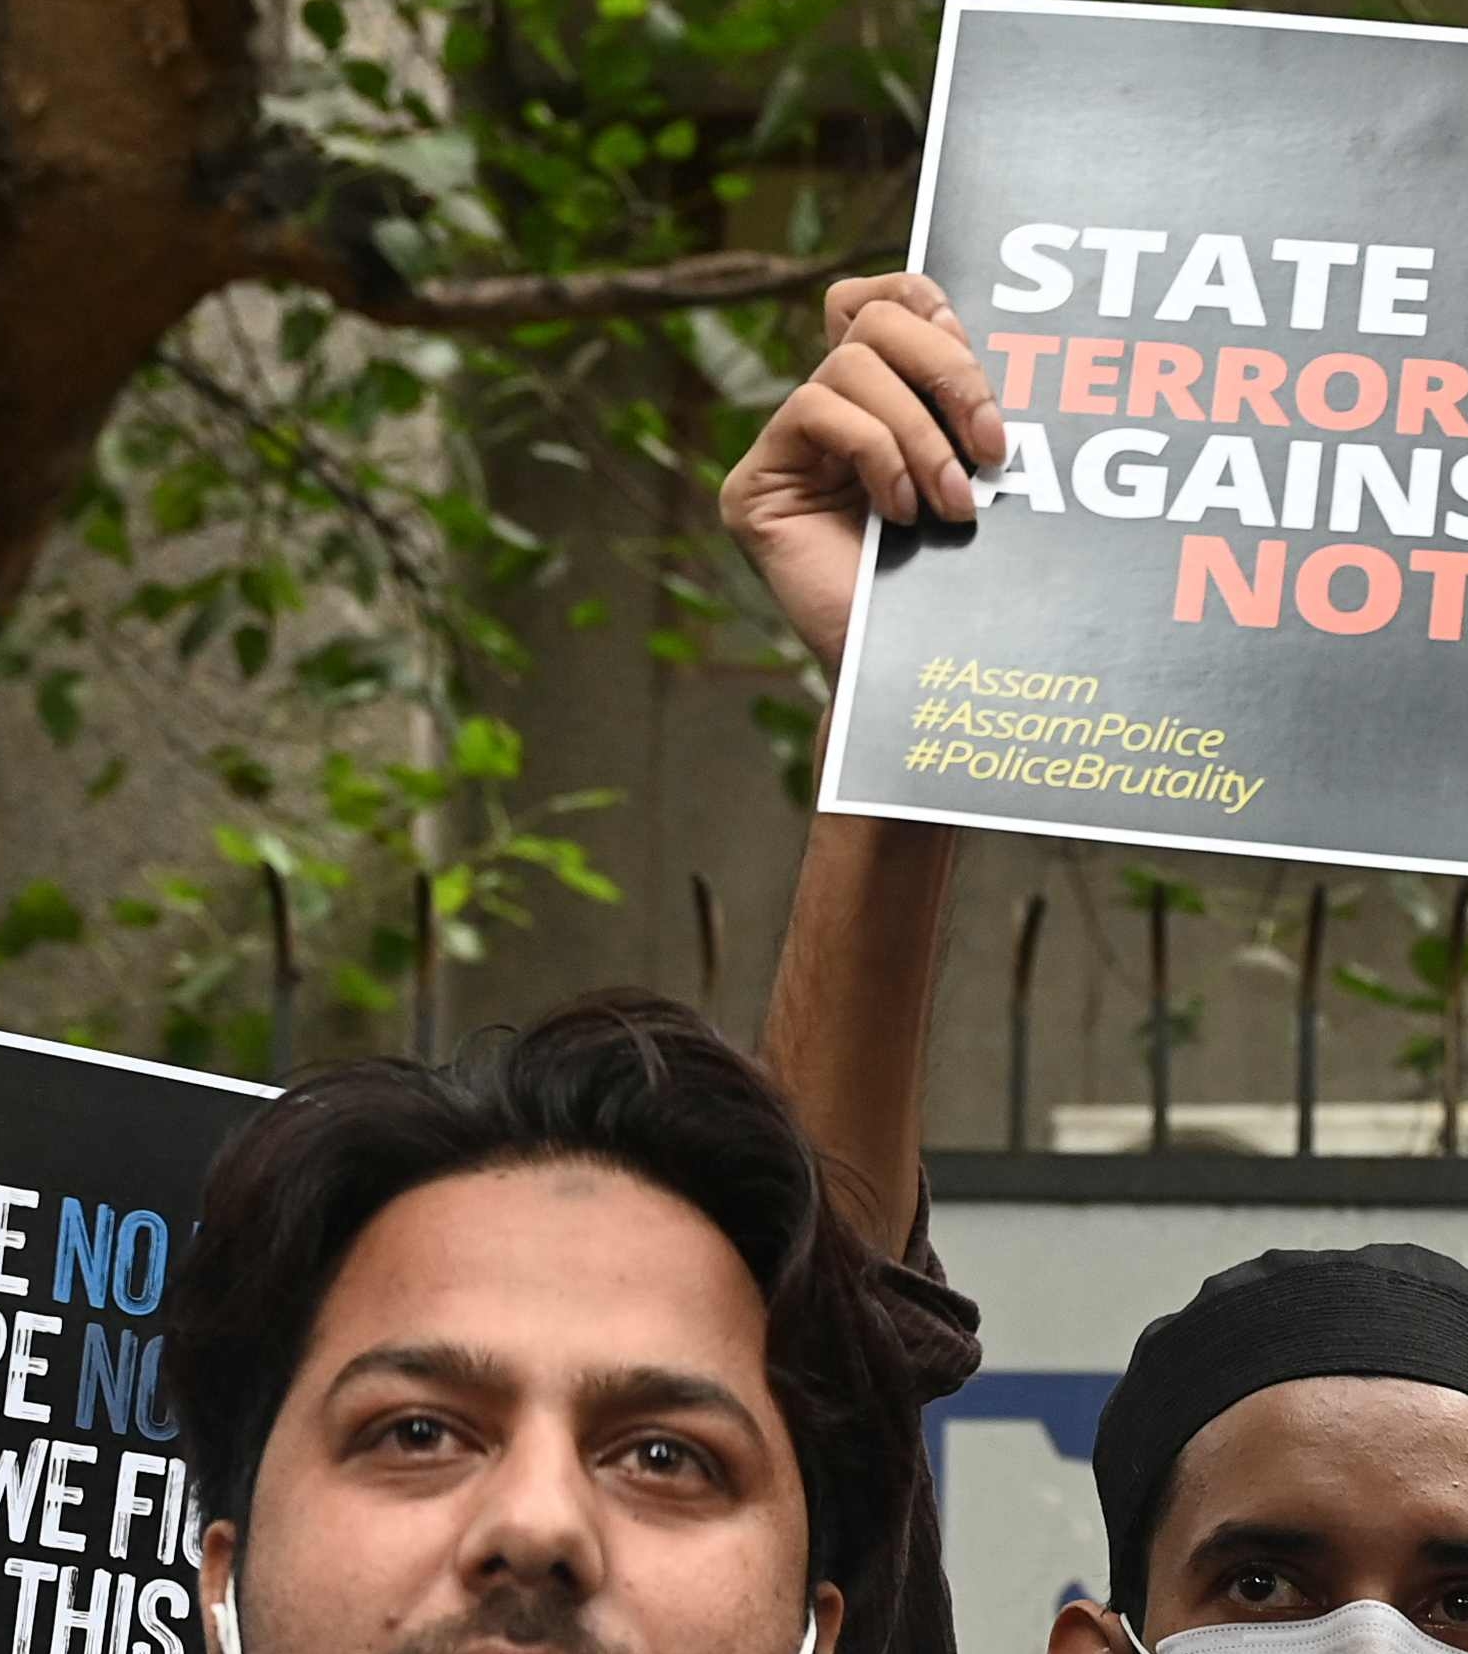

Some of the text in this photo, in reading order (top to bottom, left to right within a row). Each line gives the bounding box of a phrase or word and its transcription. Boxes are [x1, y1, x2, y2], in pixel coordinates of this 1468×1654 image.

[991, 223, 1434, 336] STATE
[918, 656, 1098, 705] #Assam
[912, 698, 1226, 759] #AssamPolice
[904, 738, 1265, 814] #PoliceBrutality
[53, 1196, 169, 1316] NO
